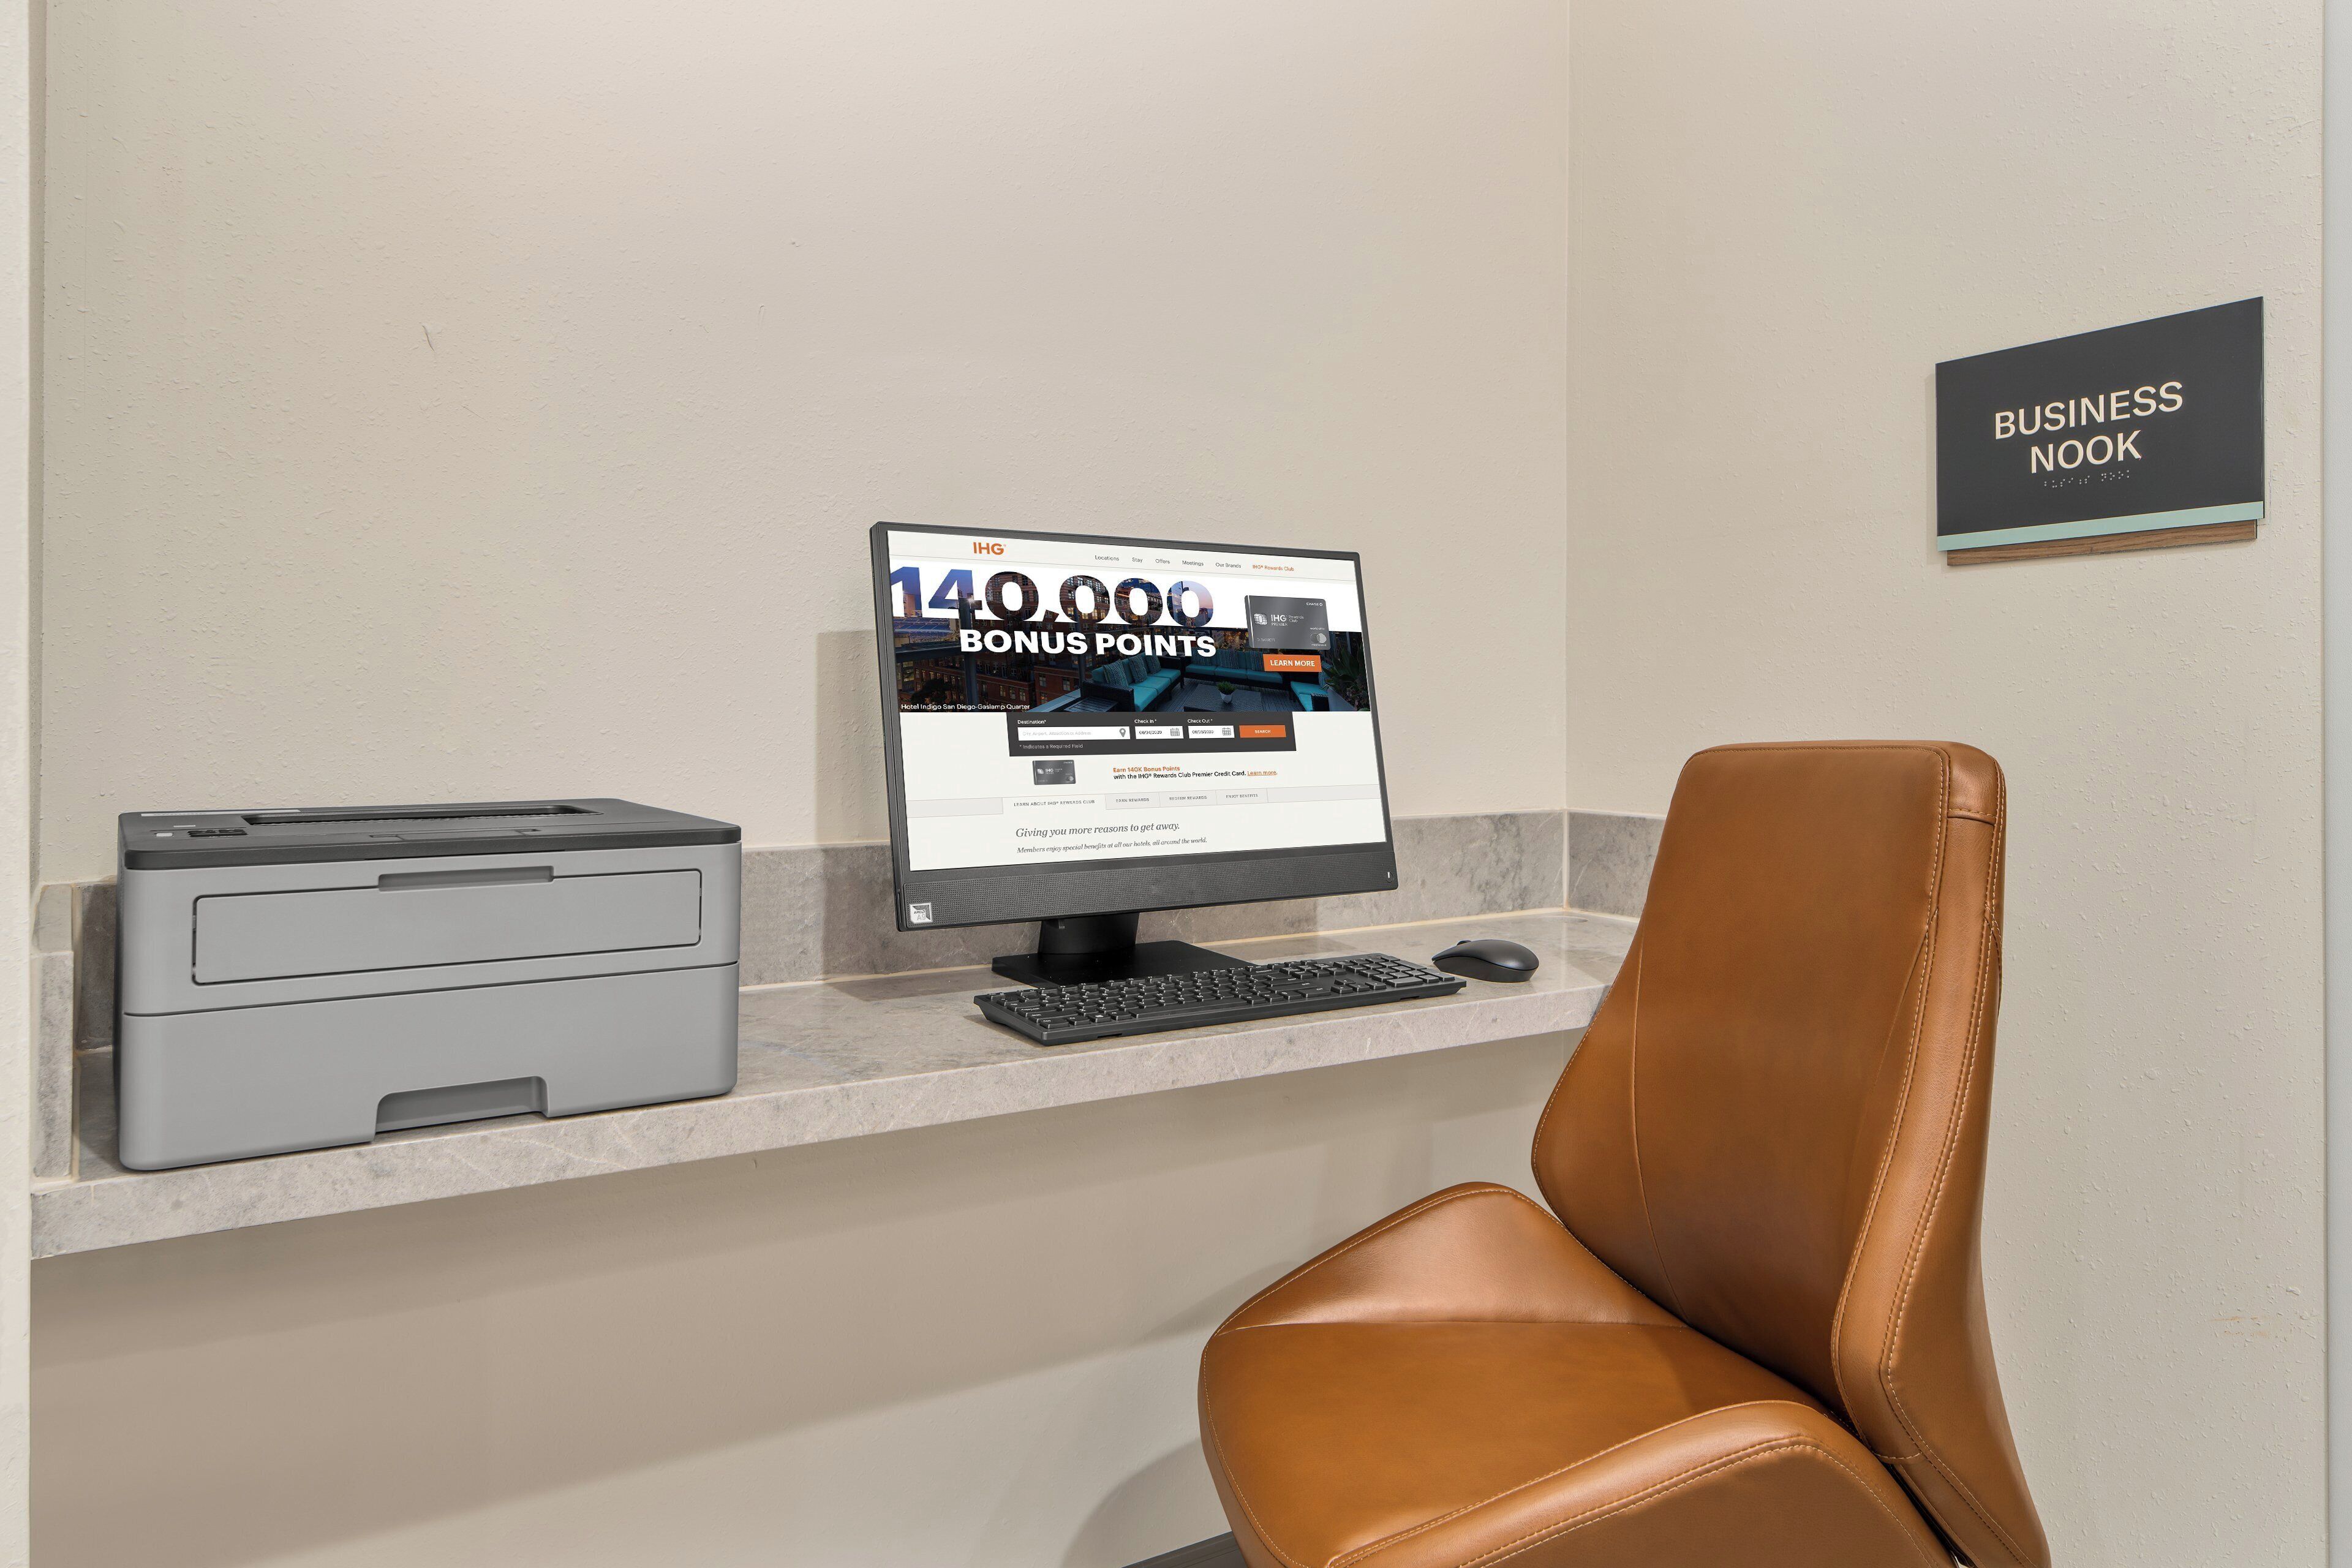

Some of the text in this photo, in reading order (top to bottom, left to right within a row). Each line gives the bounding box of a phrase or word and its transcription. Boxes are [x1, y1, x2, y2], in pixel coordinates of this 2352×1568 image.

[1995, 381, 2184, 440] BUSINESS
[2031, 430, 2141, 474] NOOK
[890, 566, 1215, 628] 140,000
[960, 628, 1216, 657] BONUS POINTS
[1016, 827, 1048, 838] Giving
[1049, 829, 1067, 838] you
[1140, 824, 1155, 834] get
[1156, 823, 1180, 832] away.
[1061, 843, 1084, 852] special
[1084, 842, 1106, 851] benefits
